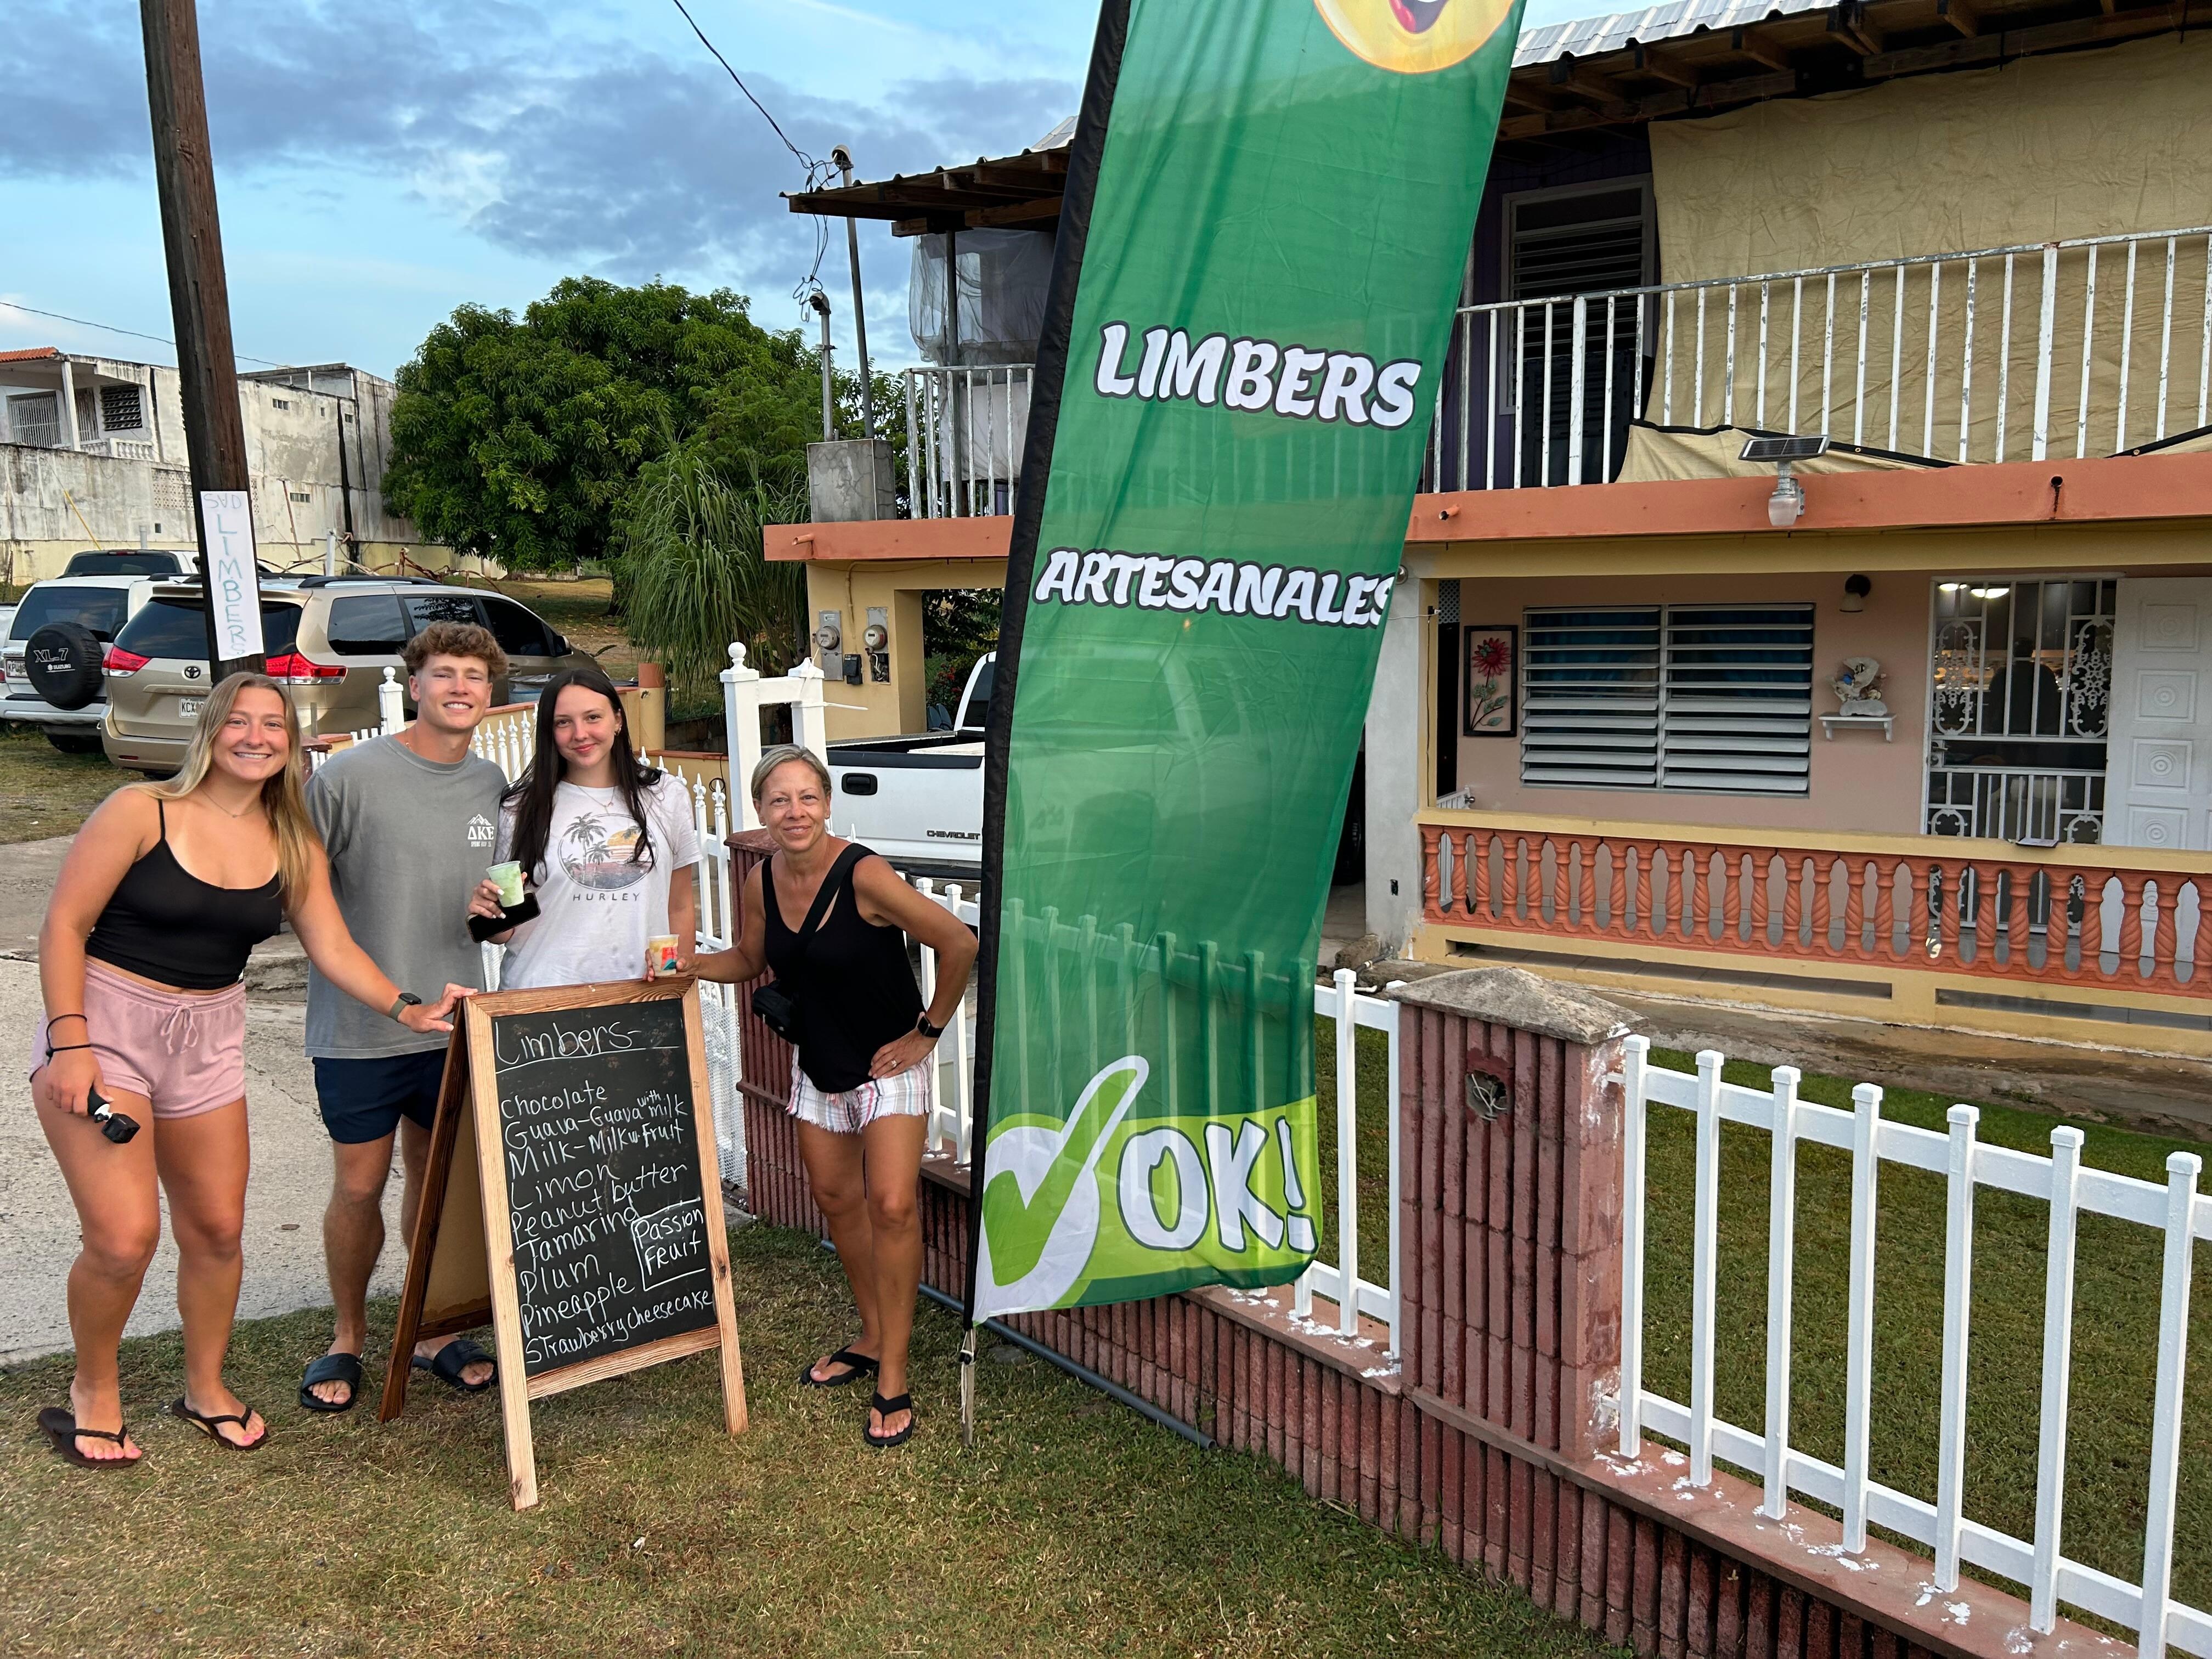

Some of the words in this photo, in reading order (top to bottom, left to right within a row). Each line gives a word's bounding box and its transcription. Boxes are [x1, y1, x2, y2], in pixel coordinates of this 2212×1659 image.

[1094, 321, 1423, 430] LIMBERS
[217, 513, 246, 656] LIMBERS
[33, 648, 69, 663] XL-7
[927, 830, 980, 840] CHEVROLET
[573, 893, 640, 901] HURLEY
[511, 1164, 620, 1210] Limon
[511, 1188, 603, 1245] Peanut
[611, 1163, 687, 1204] butter
[1117, 1115, 1317, 1253] OK!
[516, 1195, 640, 1272] Tamarind
[634, 1209, 704, 1249] Passion
[520, 1254, 601, 1304] Plum
[520, 1273, 635, 1338] Pineapple
